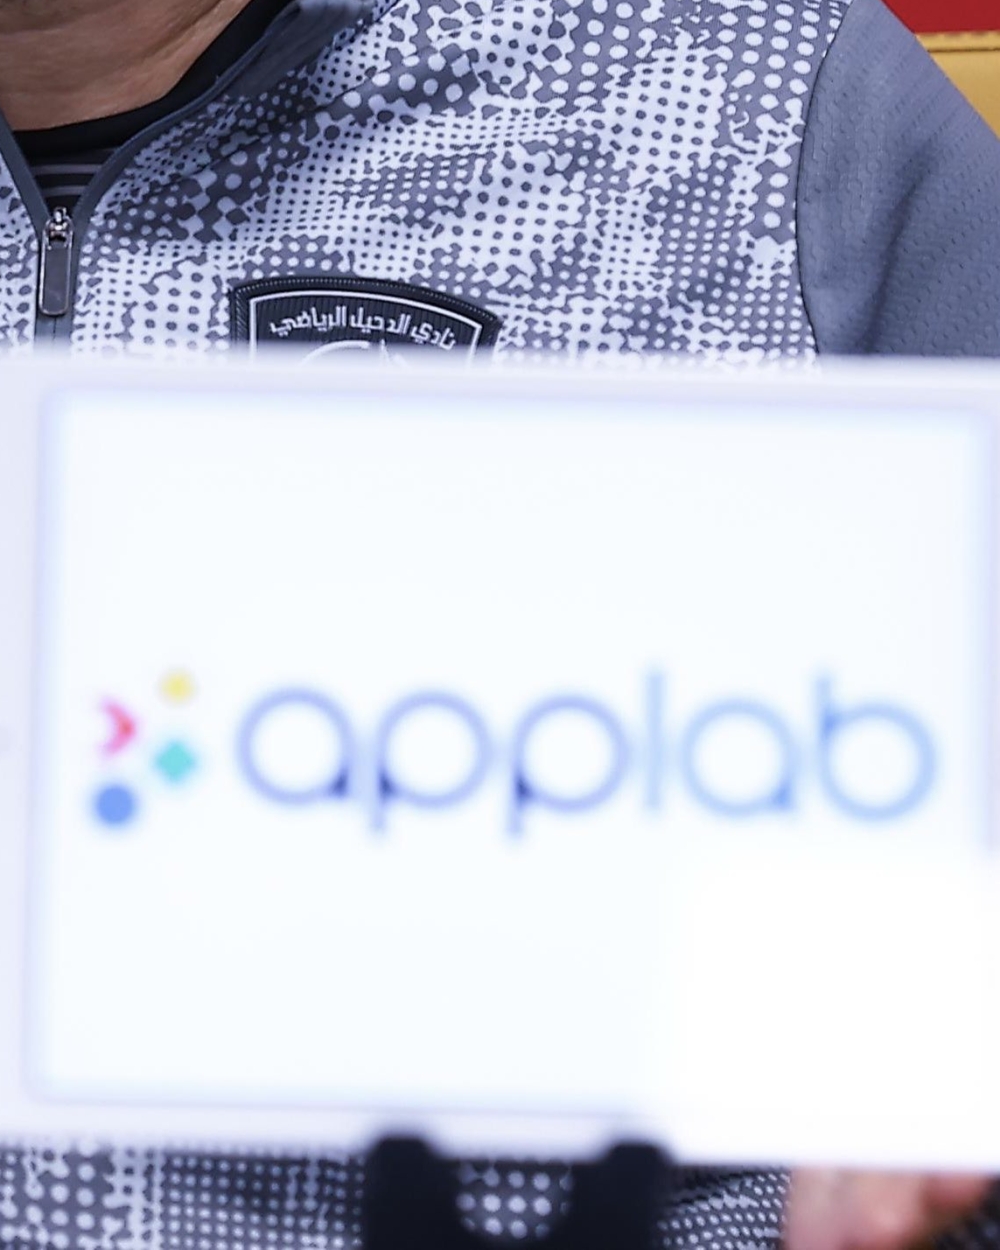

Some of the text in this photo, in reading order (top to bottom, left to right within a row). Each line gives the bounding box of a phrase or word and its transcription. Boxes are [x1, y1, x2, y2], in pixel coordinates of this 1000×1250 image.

[269, 305, 457, 351] نادي الدحيل الرياضي
[236, 665, 937, 839] applab
